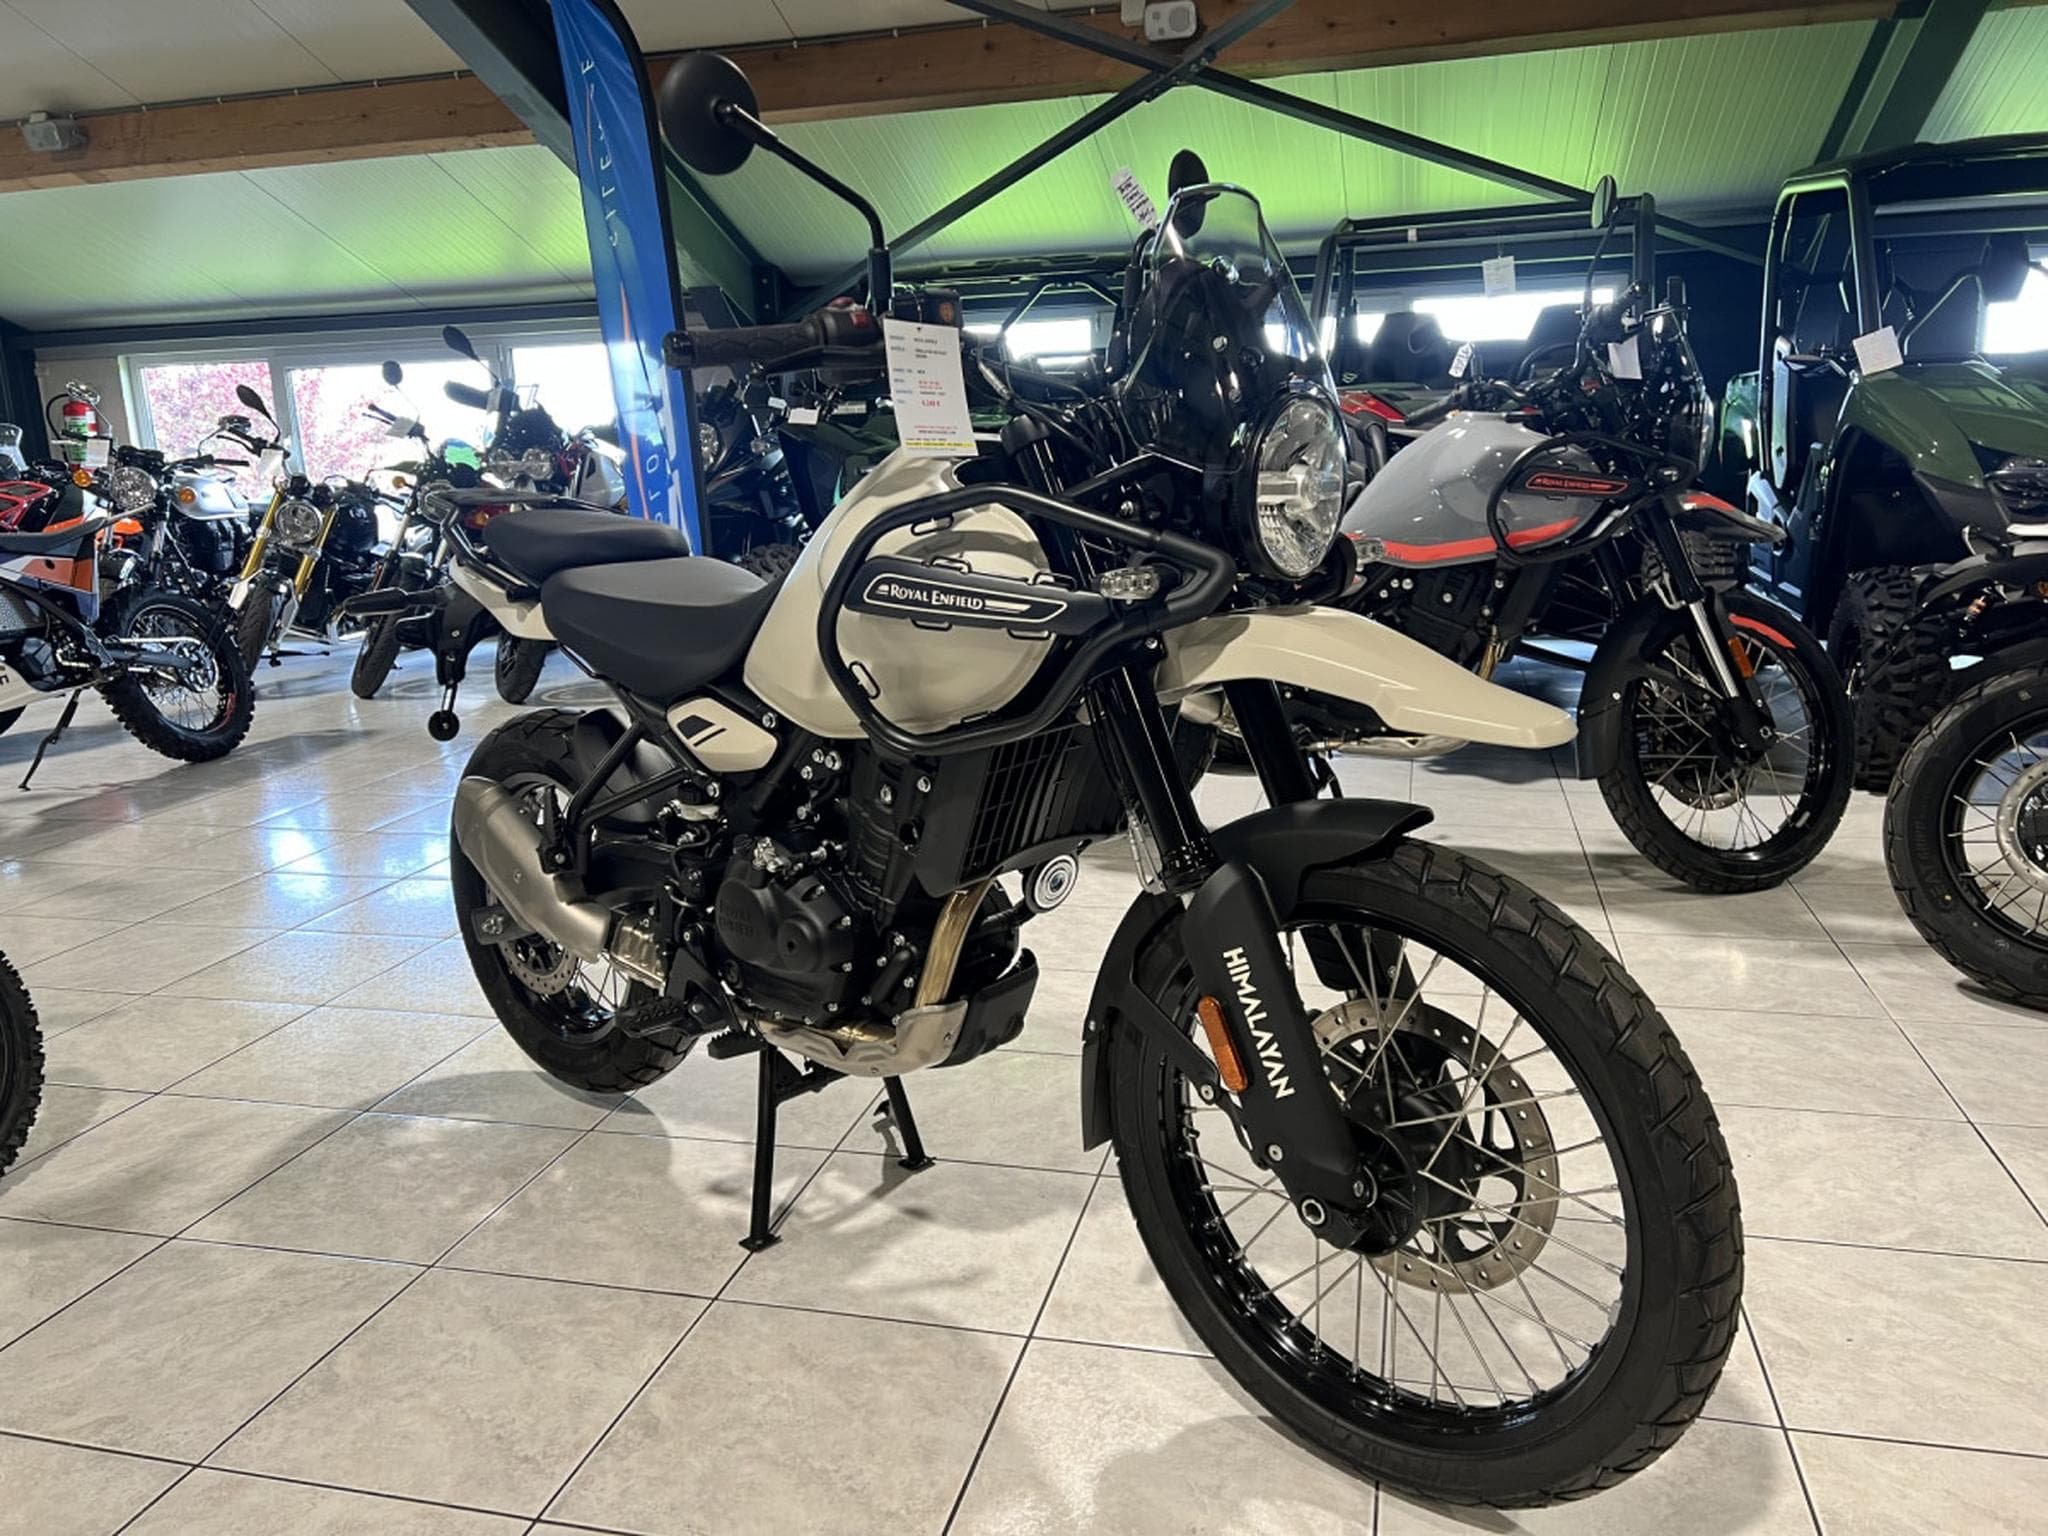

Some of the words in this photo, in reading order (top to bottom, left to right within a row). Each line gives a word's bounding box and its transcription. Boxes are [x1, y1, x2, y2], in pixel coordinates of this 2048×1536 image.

[890, 584, 929, 602] ROYAL
[931, 590, 984, 610] ENFIELD
[1223, 946, 1296, 1099] HIMALAYAN
